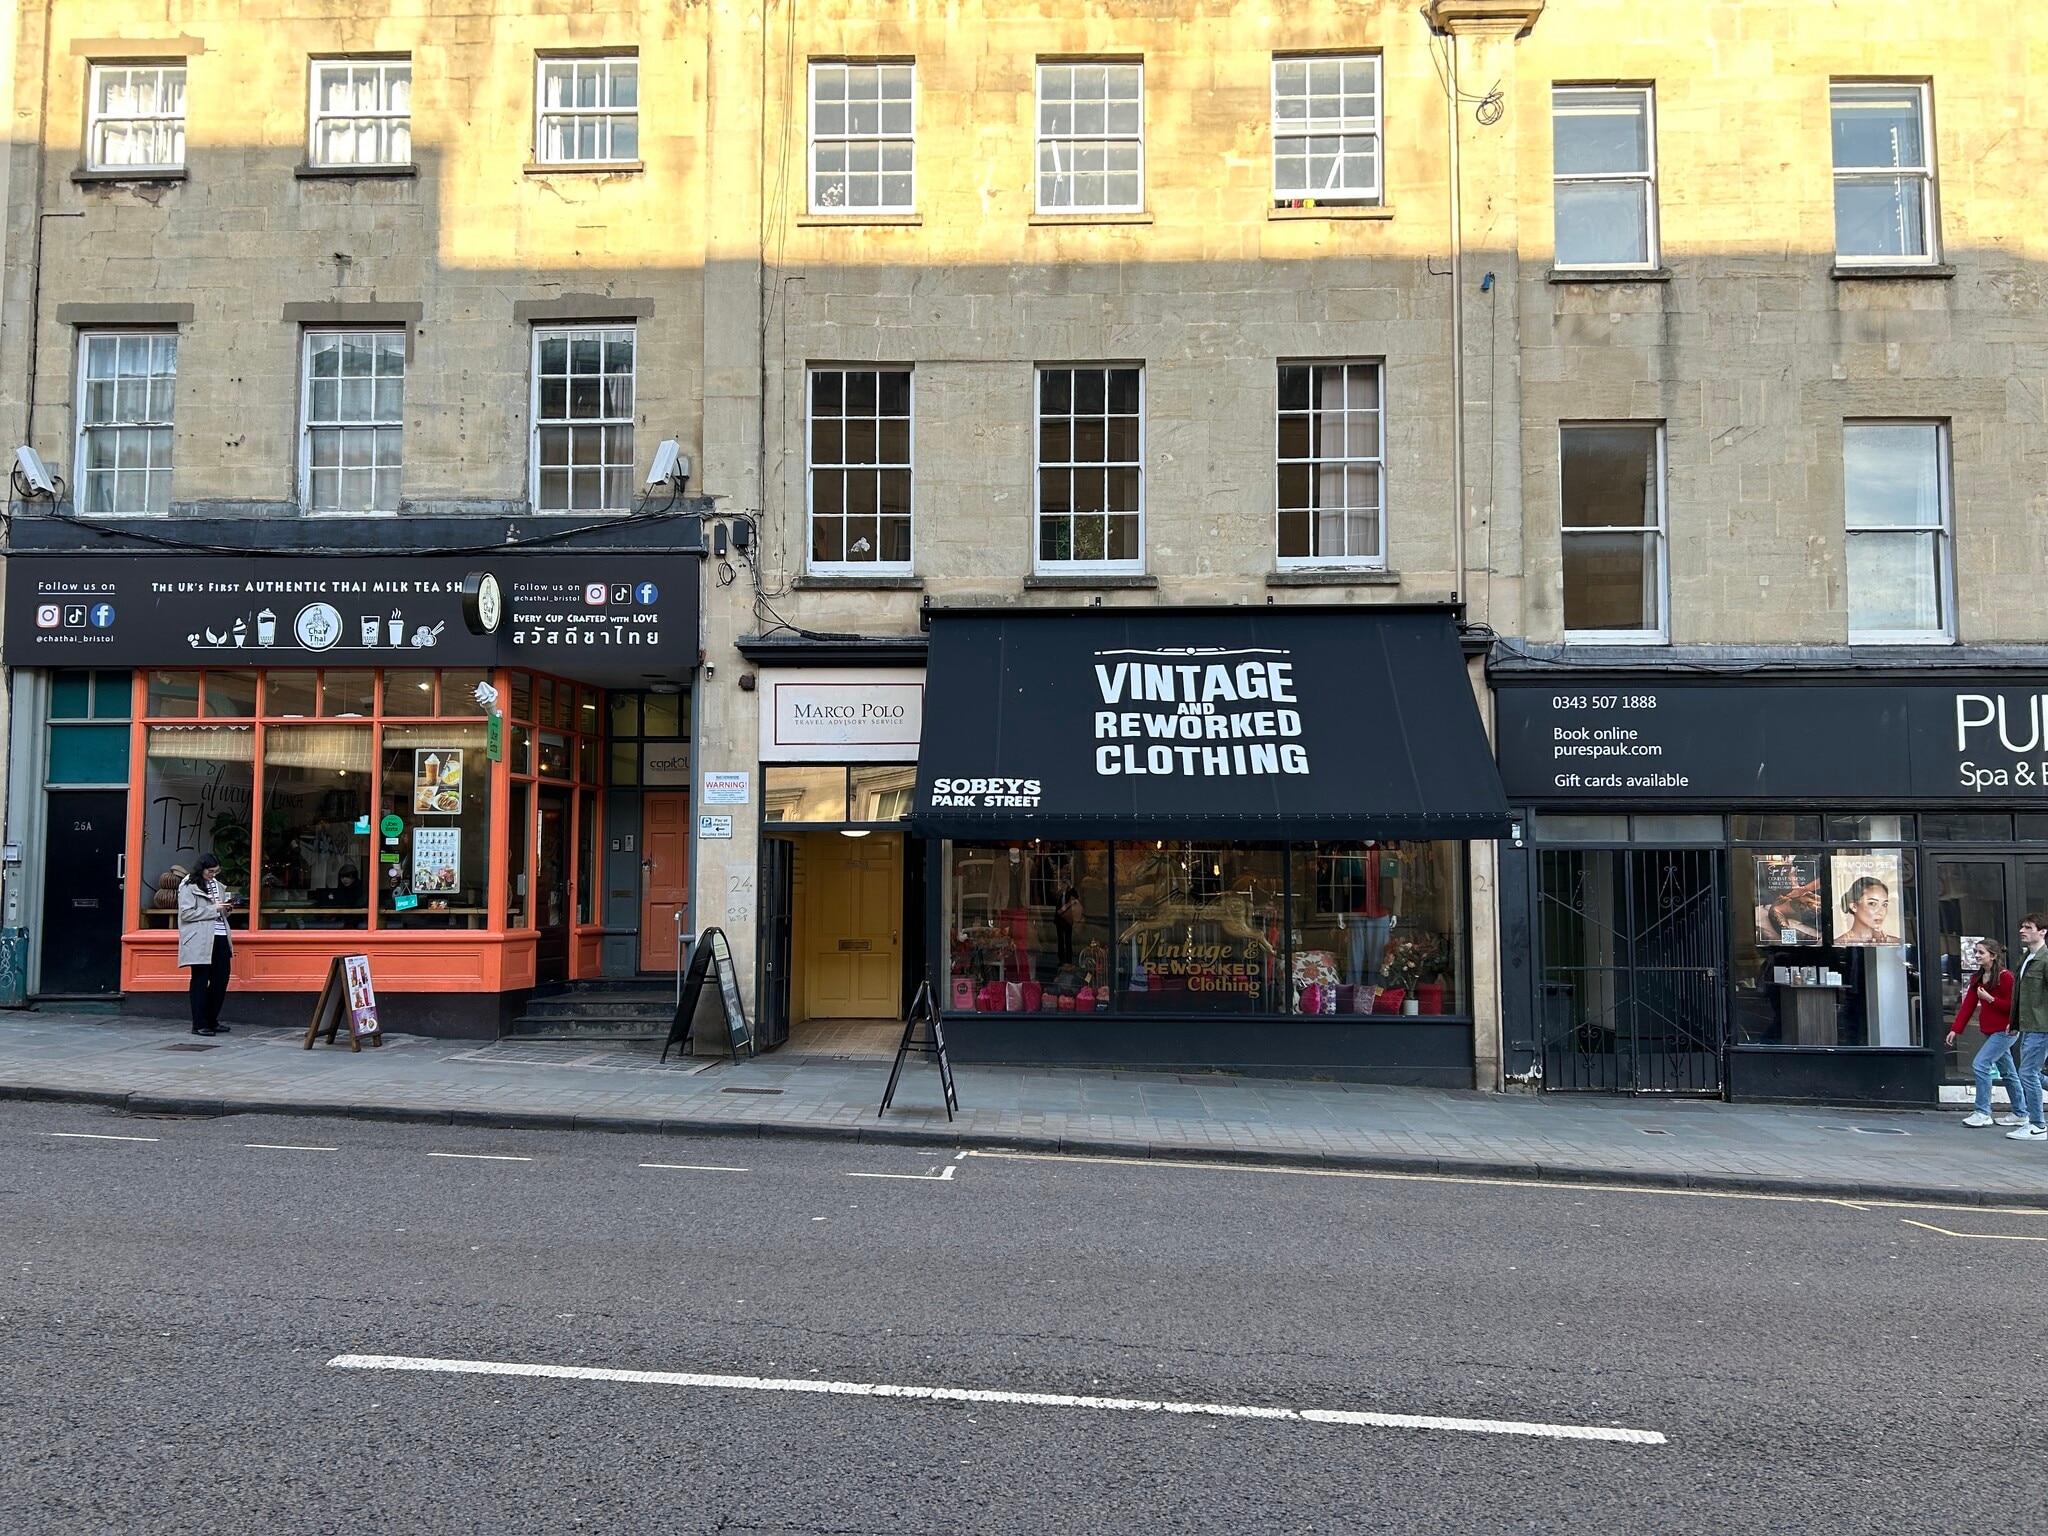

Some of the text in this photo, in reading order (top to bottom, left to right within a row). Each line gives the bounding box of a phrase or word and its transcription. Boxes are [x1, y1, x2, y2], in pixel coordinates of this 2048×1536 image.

[38, 581, 115, 591] Follow us on
[244, 581, 327, 593] AUTHENTIC
[332, 581, 366, 593] THAI
[373, 581, 408, 593] MILK
[414, 581, 440, 593] TEA
[446, 581, 463, 593] SH
[513, 583, 548, 591] Follow
[513, 614, 542, 623] EVERY
[545, 614, 564, 623] CUP
[567, 614, 607, 623] CRAFTED
[633, 614, 658, 623] LOVE
[36, 634, 114, 643] @chathai_bristol
[1095, 661, 1297, 704] VINTAGE
[1177, 702, 1216, 716] AND
[1552, 696, 1657, 709] 0343 507 1888
[794, 703, 905, 718] MARCO POLO
[1095, 709, 1302, 740] REWORKED
[1956, 694, 2048, 752] PU
[1553, 727, 1638, 740] Book online
[1553, 743, 1662, 759] purespauk.com
[1096, 743, 1310, 776] CLOTHING
[1554, 773, 1689, 787] Gift cards available
[1960, 761, 2009, 793] Spa
[2014, 761, 2037, 786] &
[932, 777, 1042, 795] SOBEYS
[931, 795, 1041, 808] PARK STREET
[73, 821, 92, 831] 26A
[153, 796, 205, 854] TEA
[1834, 861, 1894, 869] DIAMOND PEEL
[1137, 931, 1259, 969] Vintage &
[1187, 976, 1261, 999] Clothing
